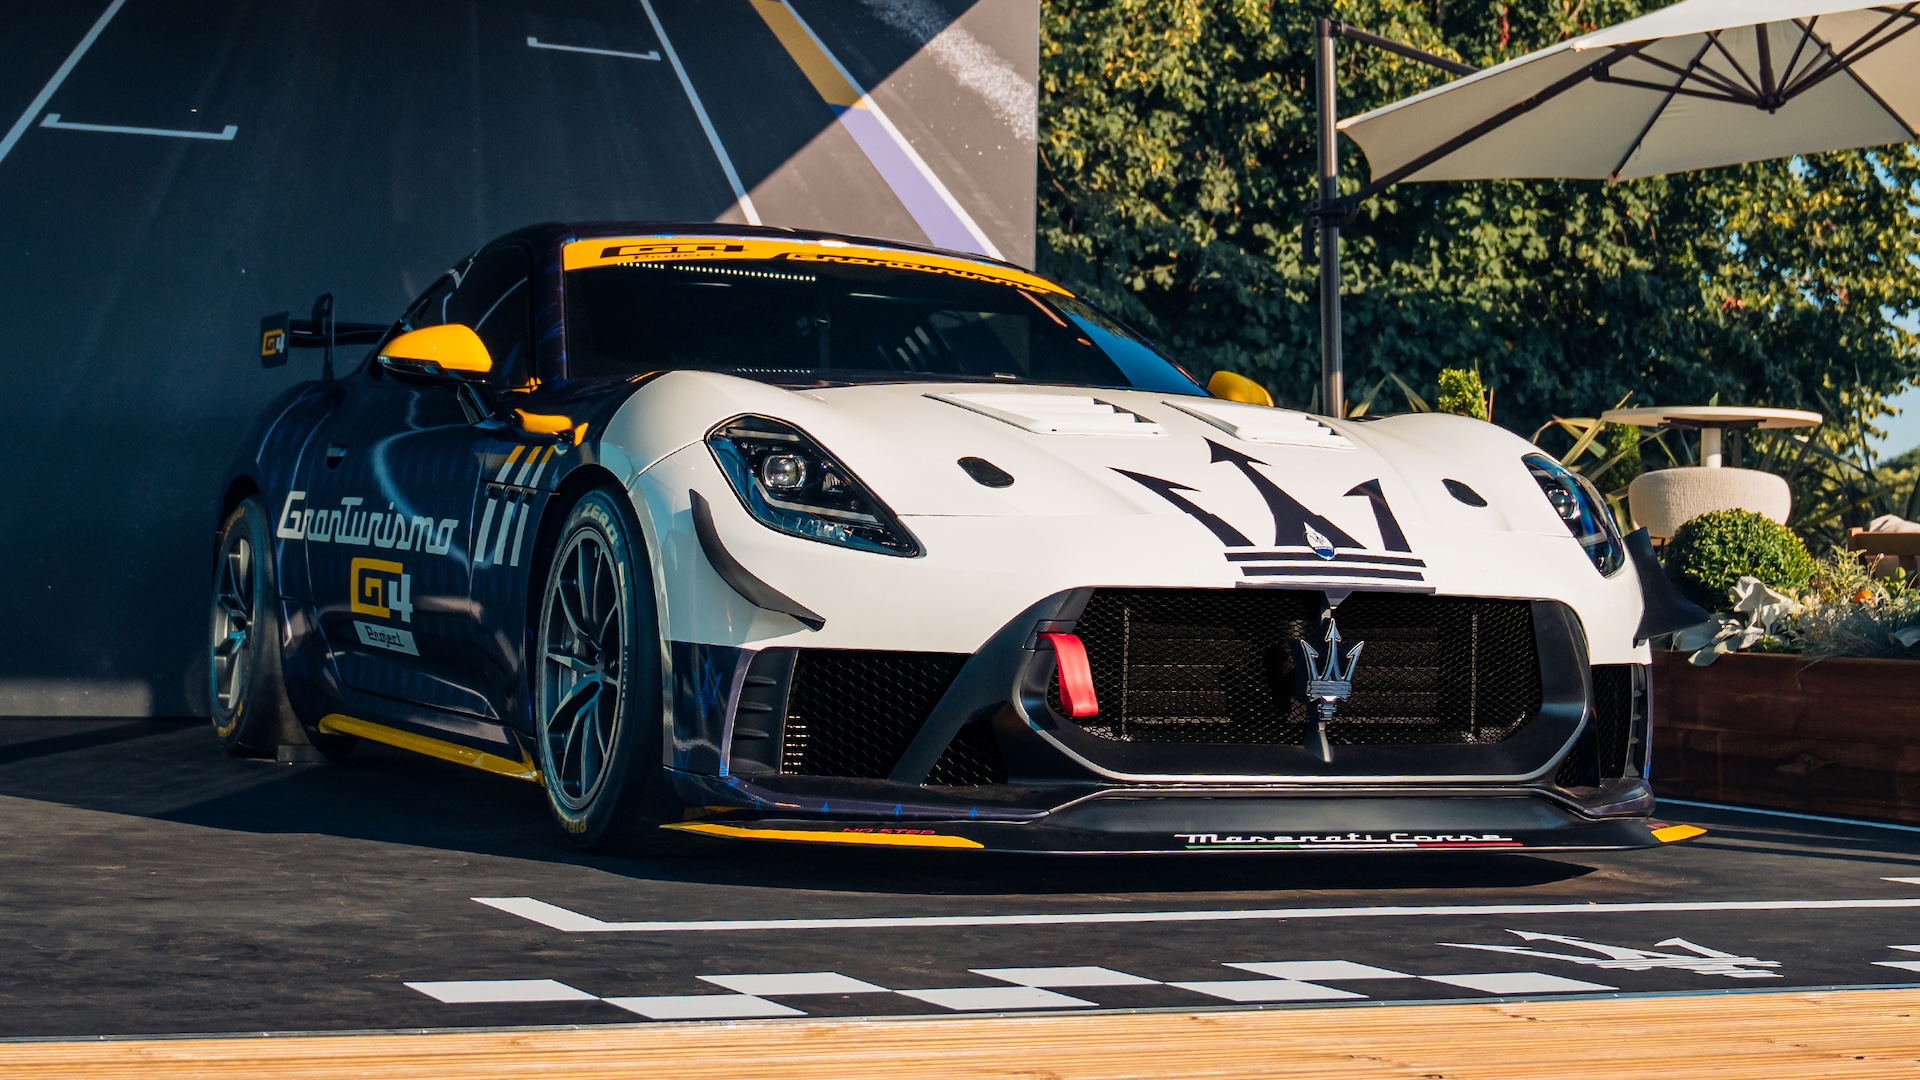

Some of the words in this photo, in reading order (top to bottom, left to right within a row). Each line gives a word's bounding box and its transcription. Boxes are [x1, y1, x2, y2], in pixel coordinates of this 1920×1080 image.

[261, 328, 286, 356] G4
[277, 490, 459, 556] GranTurismo
[350, 557, 414, 624] G4
[364, 624, 405, 648] Project
[879, 828, 936, 836] STEP
[1174, 832, 1388, 844] Maserati
[1389, 832, 1513, 842] Corse
